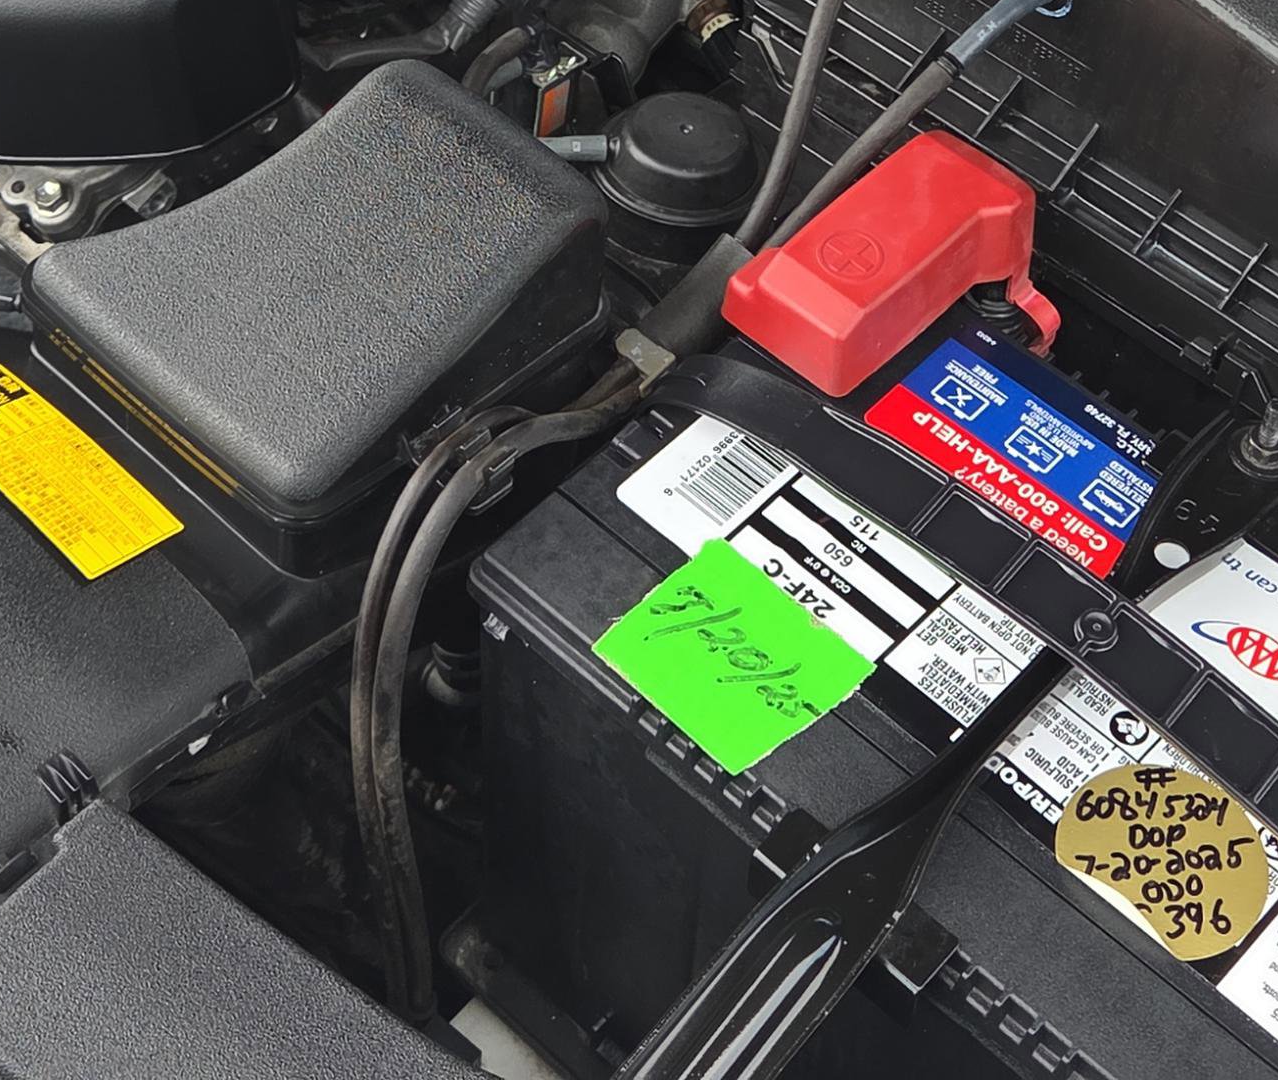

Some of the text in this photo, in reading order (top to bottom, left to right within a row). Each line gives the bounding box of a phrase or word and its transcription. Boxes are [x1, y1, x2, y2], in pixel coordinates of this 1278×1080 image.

[943, 360, 1006, 406] MAINTENANCE
[971, 363, 999, 385] FREE
[1019, 412, 1078, 457] MADE IN USA
[1113, 423, 1131, 438] FL
[1128, 433, 1153, 455] ARY,
[1113, 435, 1140, 458] LLC.
[679, 454, 712, 482] 02171
[909, 406, 1110, 551] Call: 800-AAA-HELP
[1108, 459, 1154, 494] NSTALLED
[662, 487, 673, 496] 6
[952, 463, 1030, 521] battery?
[848, 513, 882, 542] 115
[1027, 514, 1045, 530] a
[822, 540, 855, 568] 650
[849, 538, 867, 553] RC
[759, 555, 835, 620] 24F-C
[828, 573, 852, 594] CCA
[1240, 564, 1278, 596] can
[951, 592, 990, 625] BATTERY.
[915, 626, 938, 646] GET
[924, 617, 969, 655] MEDICAL
[933, 611, 986, 655] HELP FAST.
[987, 620, 1012, 641] OPEN
[998, 614, 1018, 632] TIP.
[1014, 627, 1037, 647] NOT
[1008, 636, 1030, 655] NOT
[918, 659, 984, 714] IMMEDIATELY
[929, 652, 992, 704] WITH WATER.
[1077, 675, 1116, 708] INSTRUC
[917, 675, 974, 723] FLUSH EYES
[1083, 694, 1108, 715] READ
[1050, 724, 1079, 750] CAUSE
[1057, 714, 1092, 744] SEVERE
[1075, 744, 1096, 763] CAN
[1089, 739, 1105, 755] OR
[1023, 746, 1074, 789] SULFURIC
[1055, 754, 1083, 779] ACID
[1133, 767, 1177, 791] #
[1128, 824, 1186, 849] DOP
[1074, 837, 1254, 880] 7-20-2025
[1141, 874, 1203, 902] ODO
